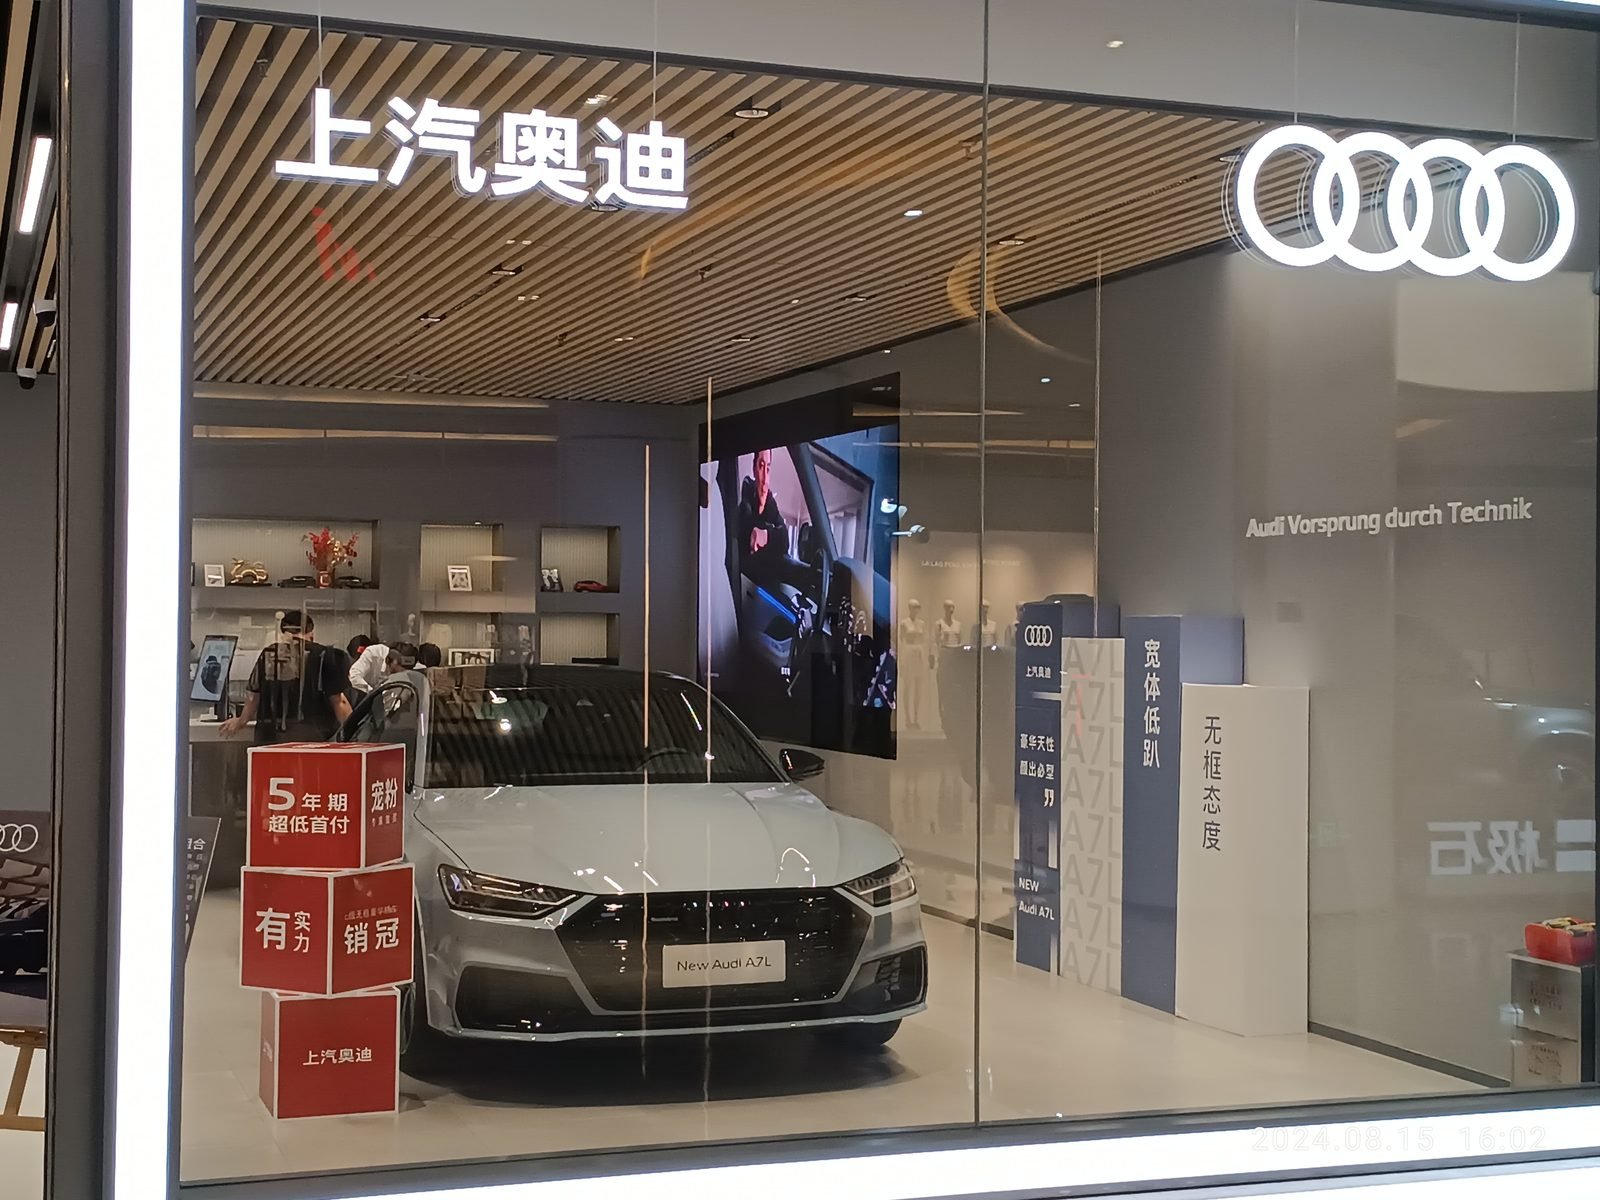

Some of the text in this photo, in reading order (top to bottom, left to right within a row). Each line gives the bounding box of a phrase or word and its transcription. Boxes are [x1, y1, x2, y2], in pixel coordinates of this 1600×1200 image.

[275, 87, 689, 209] 上汽奥迪
[1246, 497, 1533, 538] Audi Vorsprung durch Technik
[1062, 680, 1123, 723] A7L
[1142, 638, 1161, 769] 宽体低趴
[1062, 723, 1122, 768] A7L
[267, 777, 348, 812] 5年期
[371, 777, 398, 813] 宠粉
[1062, 767, 1122, 813] A7L
[1202, 716, 1222, 852] 无框态度
[268, 815, 350, 834] 超低首付
[1061, 810, 1121, 859] A7L
[1018, 877, 1039, 893] NEW
[1061, 853, 1121, 904] A7L
[1018, 900, 1055, 920] Audi A7L
[1061, 898, 1121, 950] A7L
[343, 917, 400, 954] 销冠
[677, 956, 772, 972] New Audi A7L
[302, 1046, 373, 1066] 上汽奥迪
